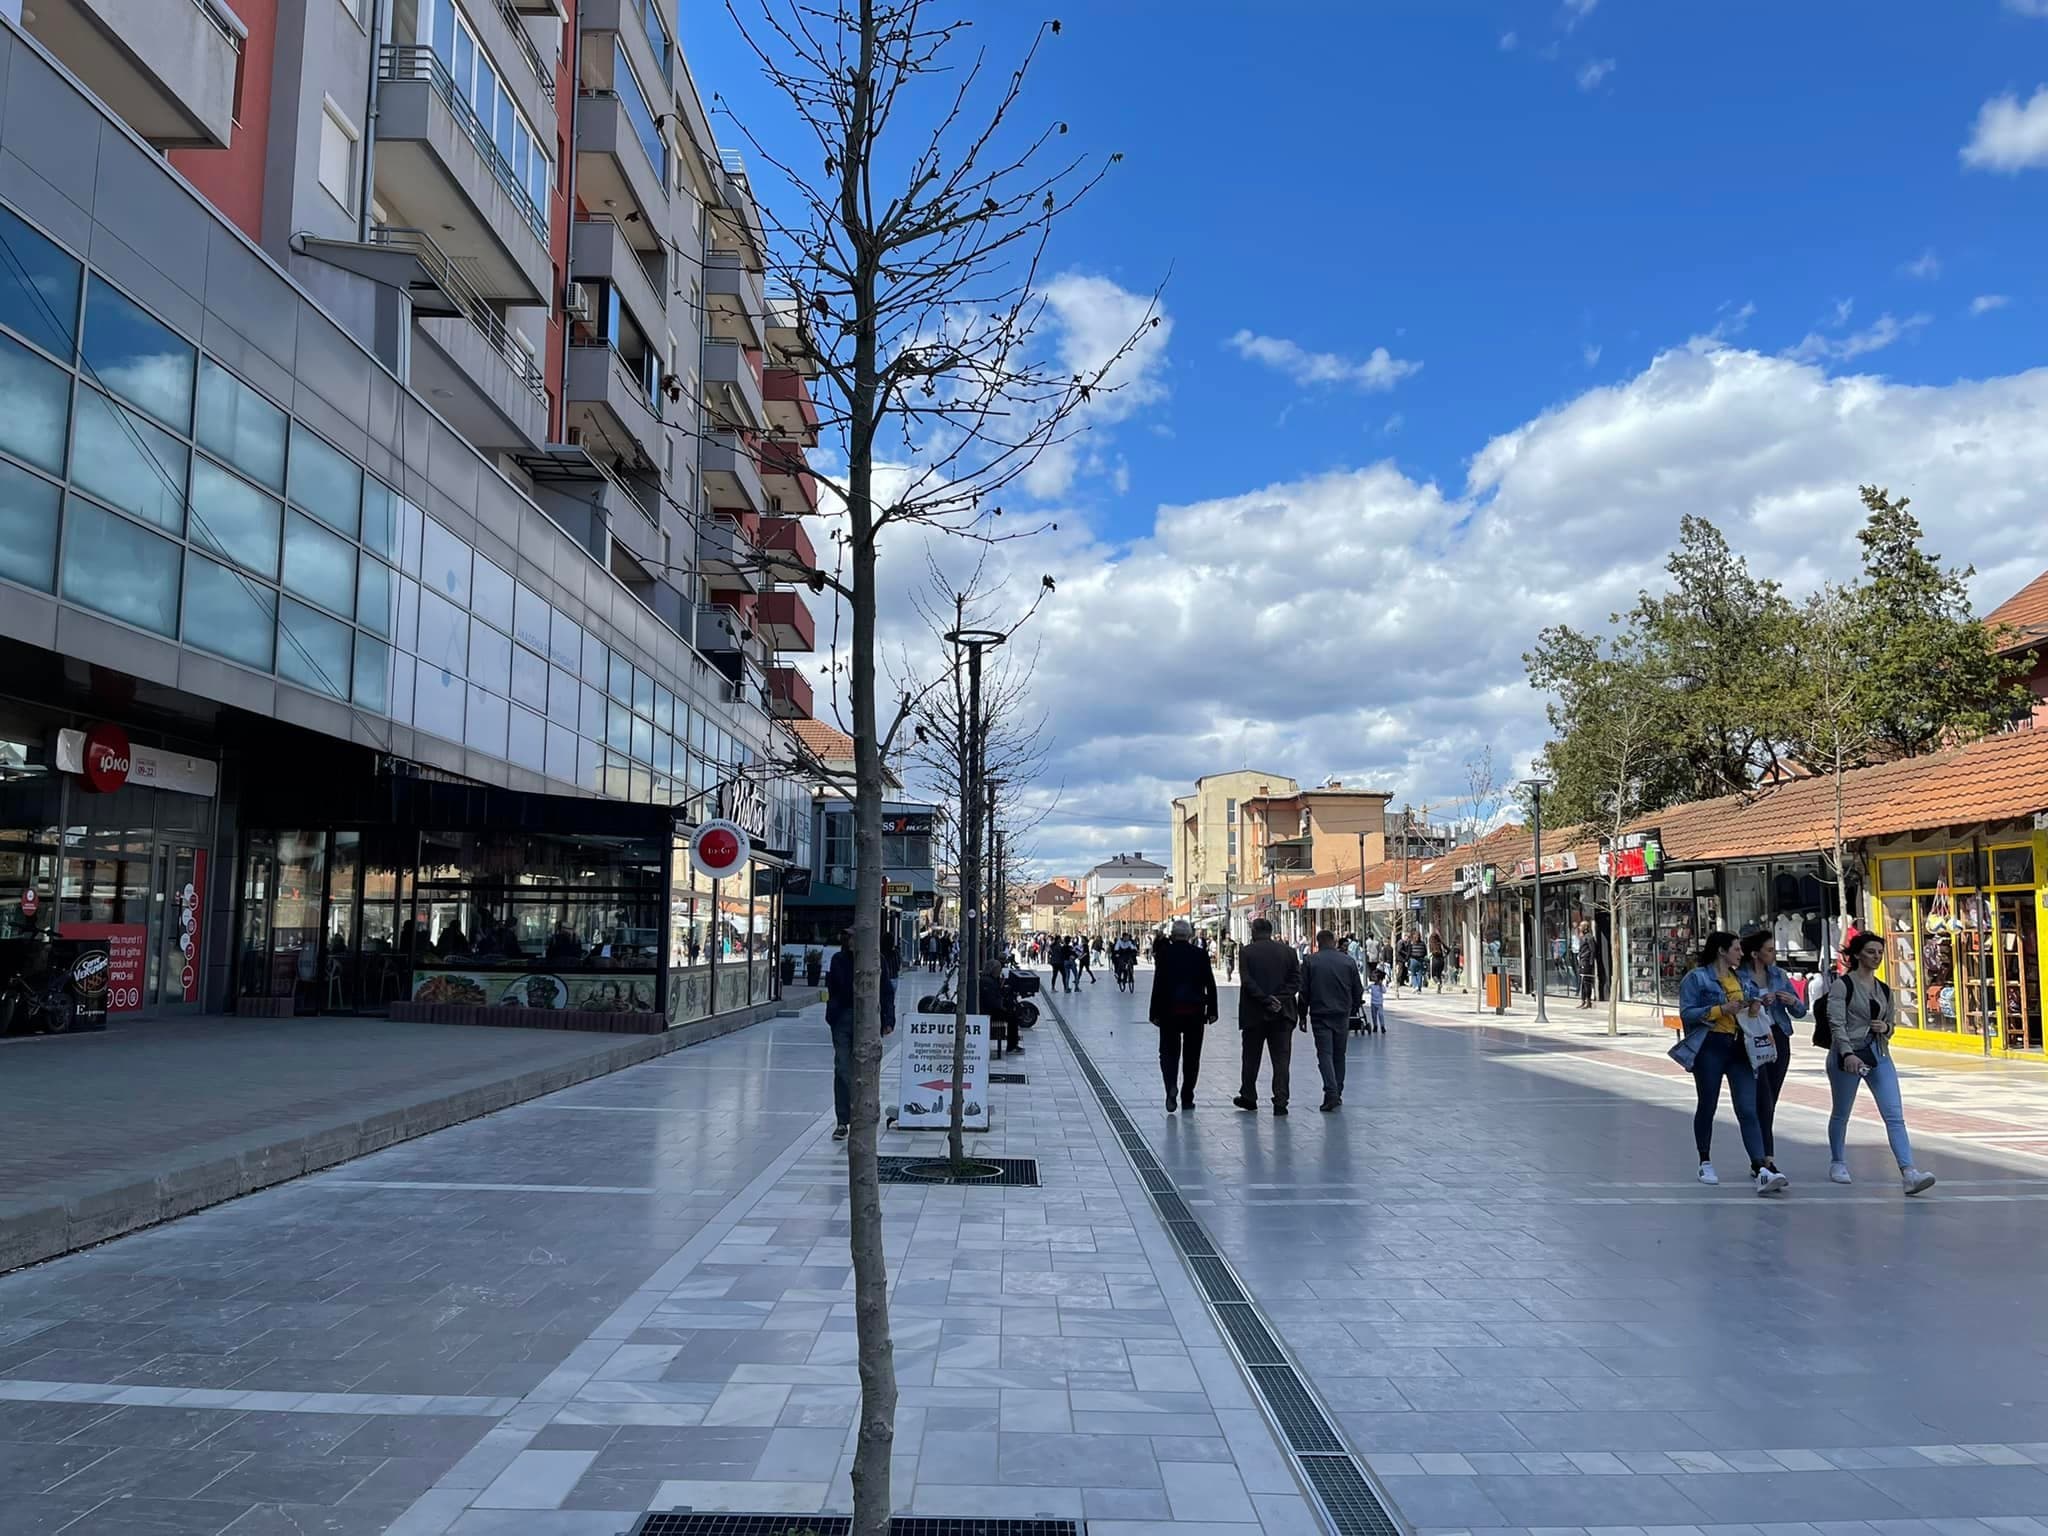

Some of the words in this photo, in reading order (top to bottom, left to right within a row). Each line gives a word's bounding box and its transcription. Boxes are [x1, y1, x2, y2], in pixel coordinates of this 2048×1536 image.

[910, 1021, 981, 1035] KËPUCAR
[913, 1063, 933, 1073] 044
[936, 1064, 975, 1074] 42759
